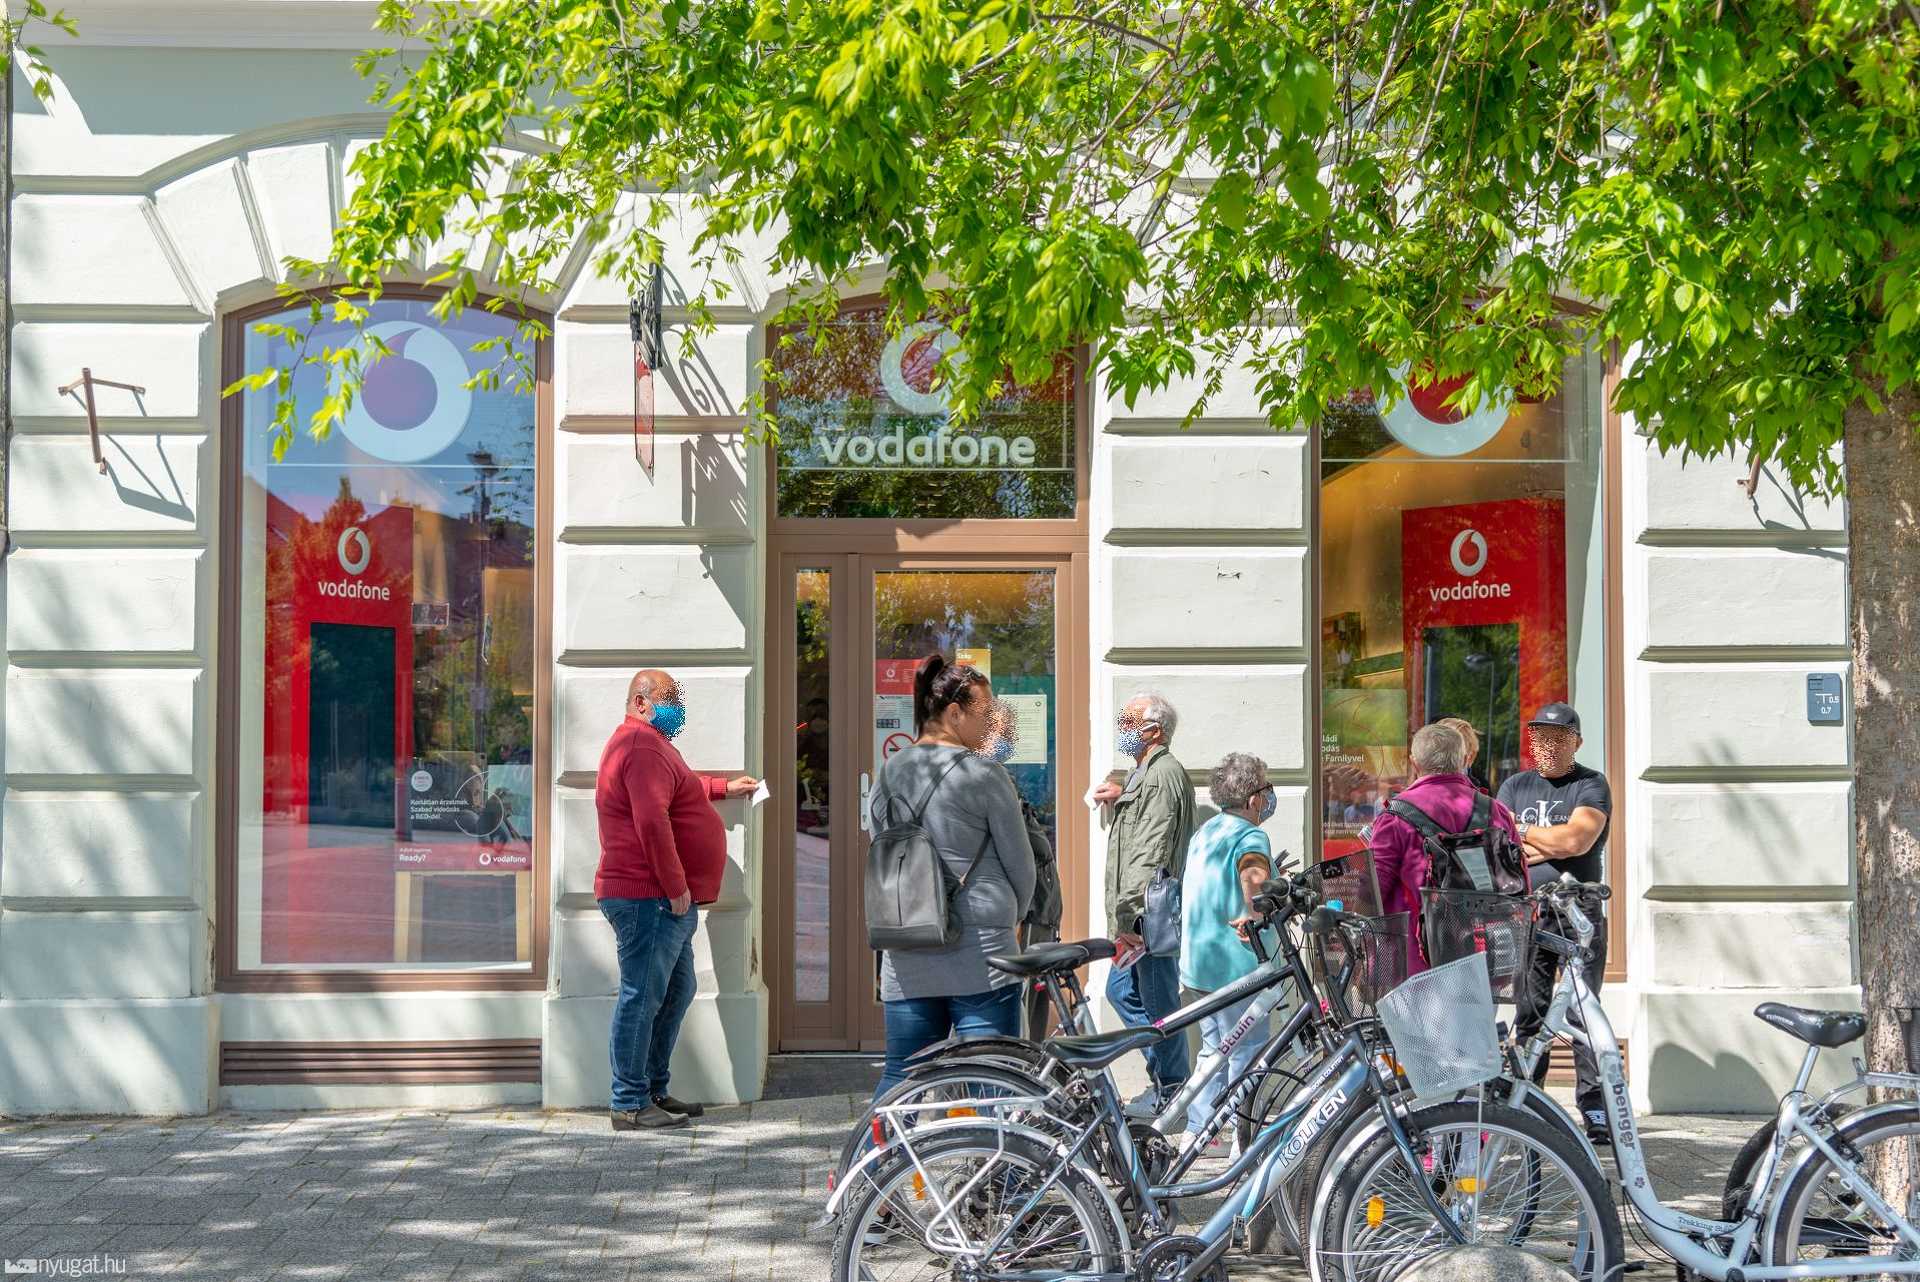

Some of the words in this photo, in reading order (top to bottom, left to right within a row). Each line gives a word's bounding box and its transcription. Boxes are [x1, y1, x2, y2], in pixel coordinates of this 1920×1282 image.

[819, 426, 1036, 465] vodafone
[318, 578, 390, 601] vodafone
[1430, 580, 1511, 601] vodafone
[1326, 754, 1364, 763] Familyvel
[399, 854, 426, 864] Ready?
[492, 855, 527, 864] vodafone
[1612, 1082, 1636, 1150] benger
